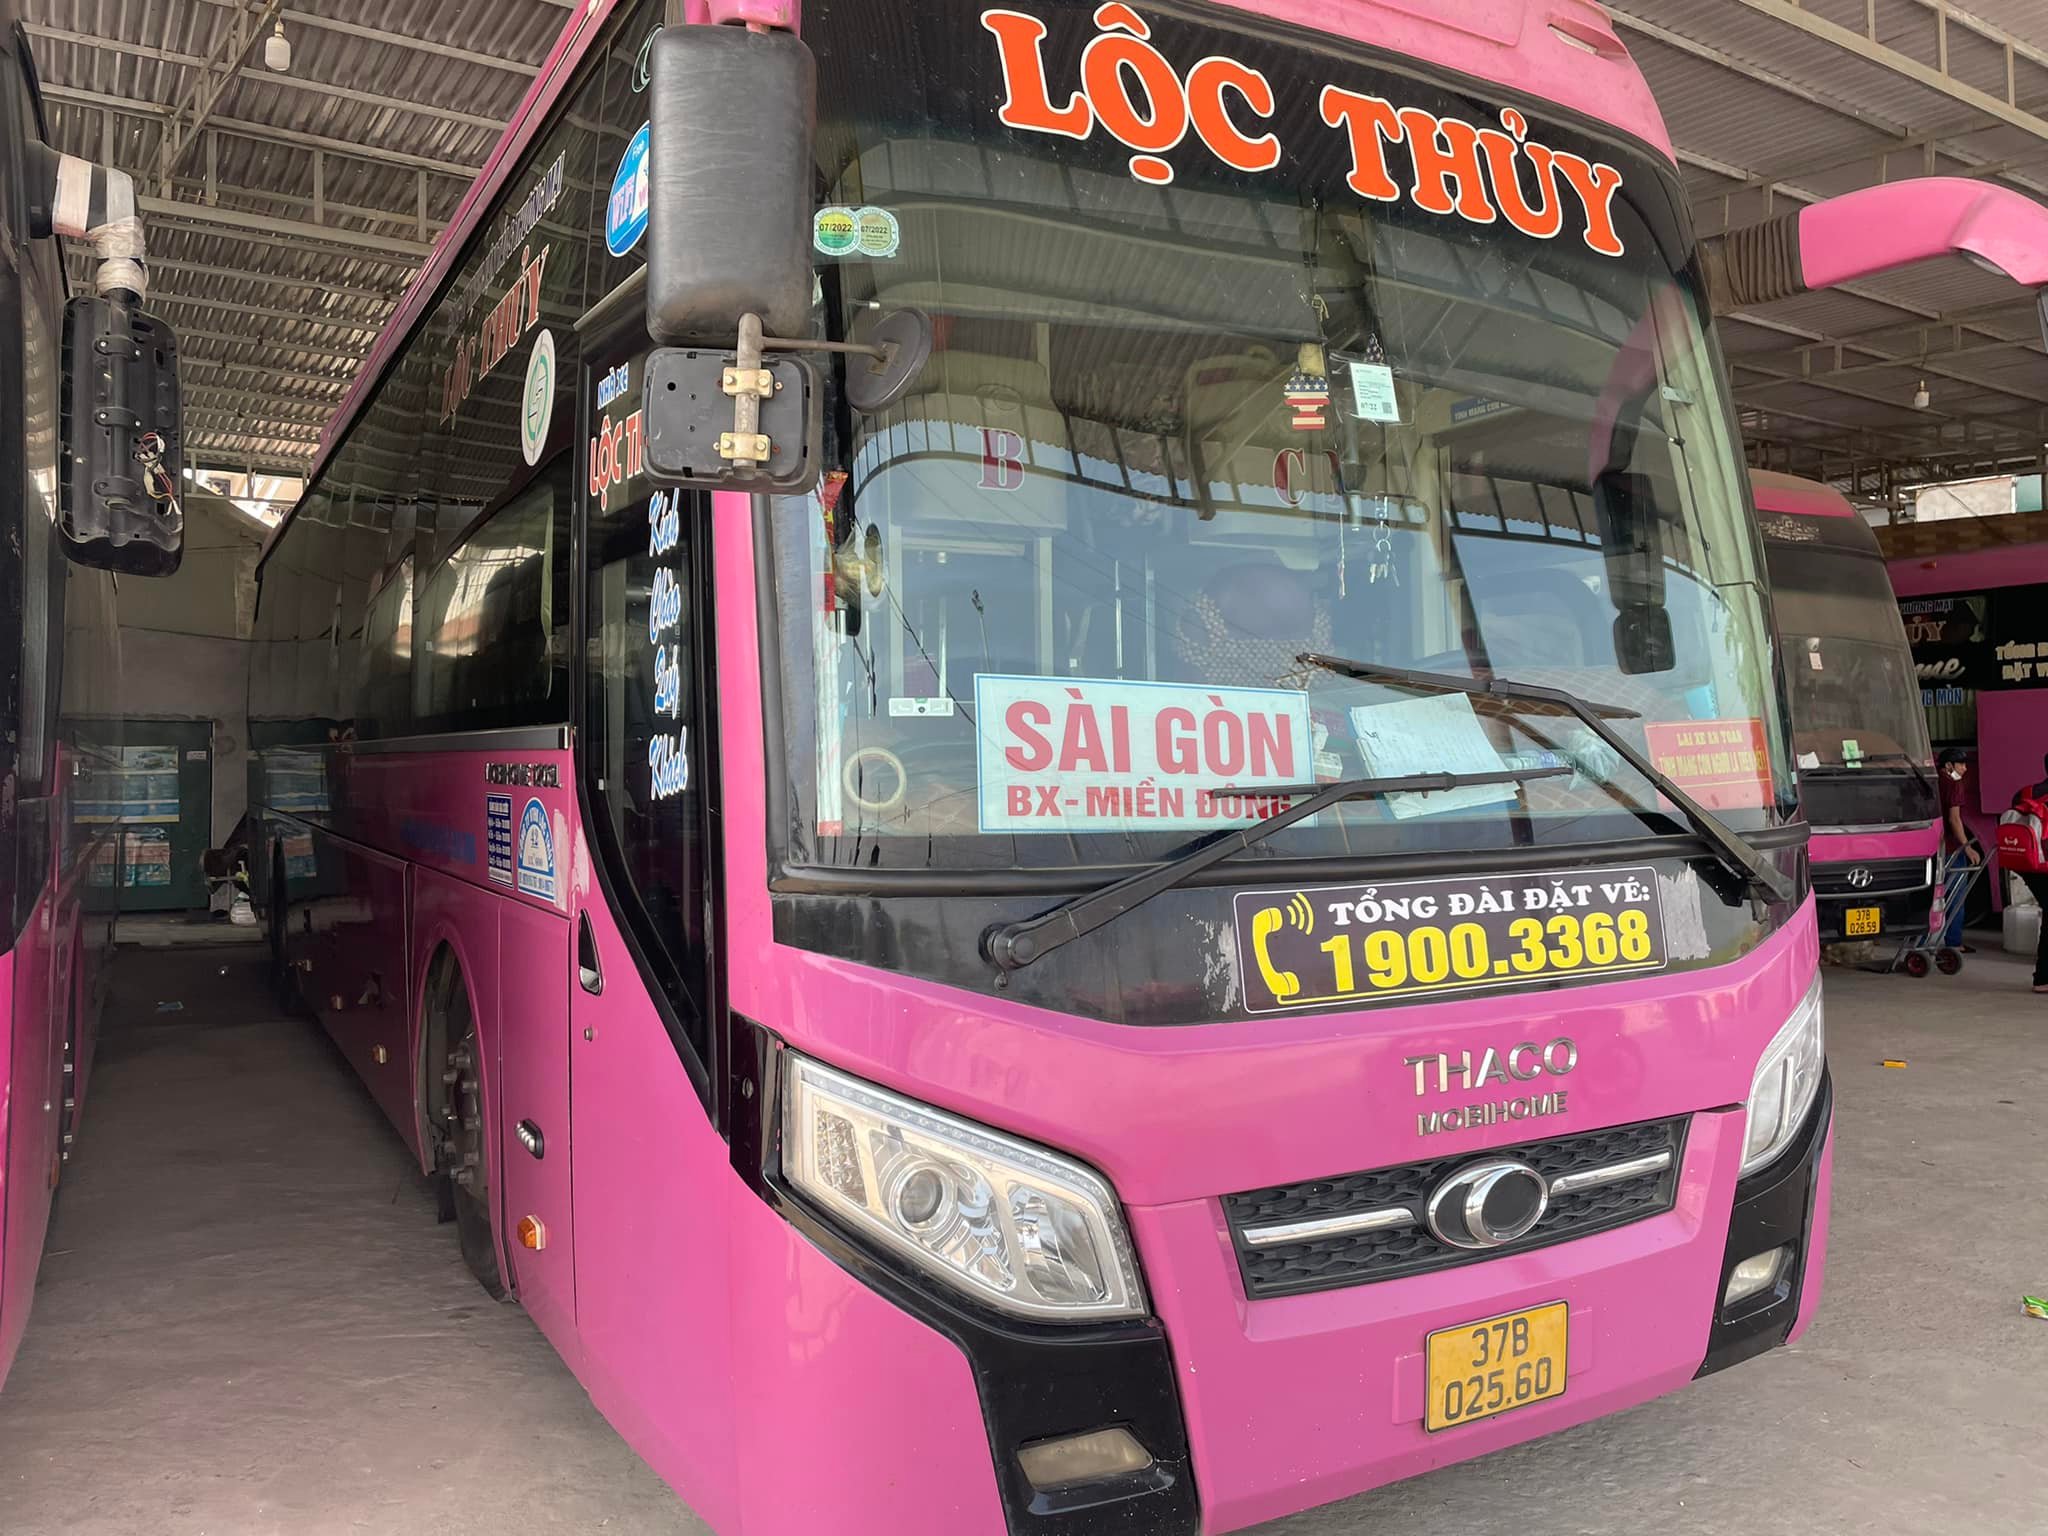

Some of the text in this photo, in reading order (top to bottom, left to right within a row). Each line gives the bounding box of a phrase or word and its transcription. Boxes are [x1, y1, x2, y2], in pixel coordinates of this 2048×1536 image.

[980, 1, 1625, 257] LỘC THỦY
[819, 223, 853, 233] 07/2022
[478, 243, 550, 383] THỦY
[597, 366, 616, 410] NHÀ
[589, 414, 623, 512] LỘC
[1004, 687, 1132, 774] SÀI
[1154, 695, 1296, 778] GÒN
[1328, 876, 1651, 926] TỔNG ĐÀI ĐẶT VÉ:
[1320, 908, 1653, 993] 1900.3368
[1402, 1037, 1578, 1096] THACO
[1416, 1091, 1569, 1136] MOBIHOME
[1471, 1317, 1529, 1367] 37B
[1445, 1357, 1552, 1420] 025.60
